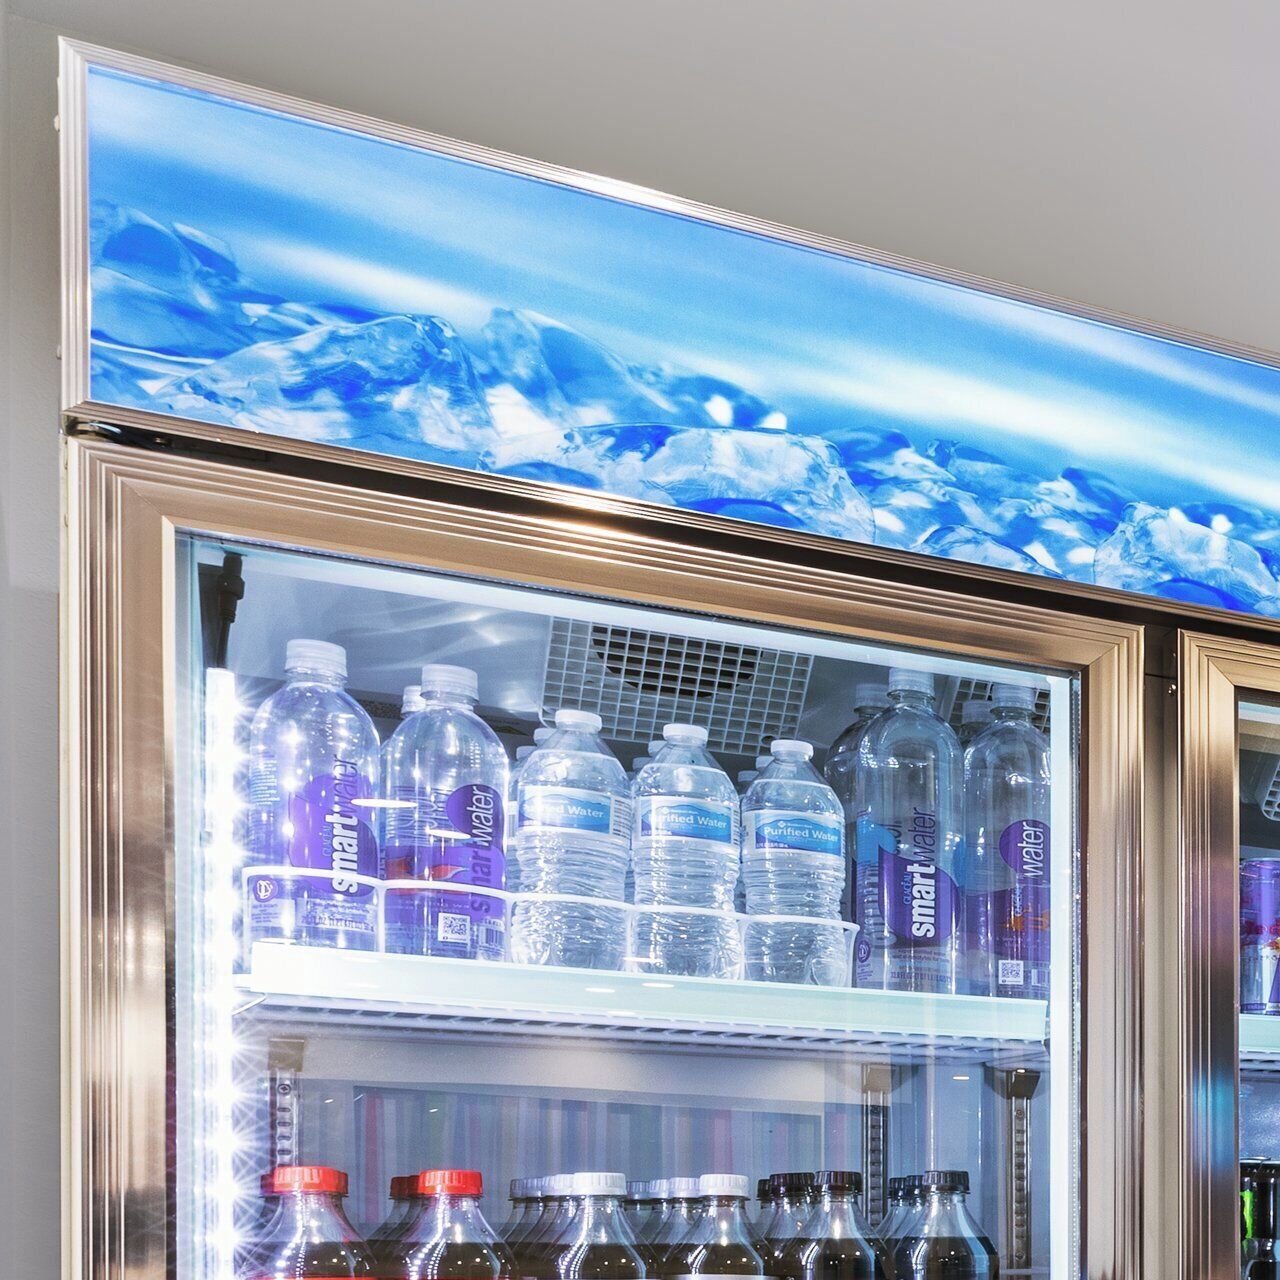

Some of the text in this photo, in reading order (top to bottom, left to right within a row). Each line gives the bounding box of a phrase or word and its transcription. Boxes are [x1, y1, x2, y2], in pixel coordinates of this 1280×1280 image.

[697, 816, 728, 829] Water
[764, 827, 839, 842] Purified Water
[912, 806, 937, 938] smartwater
